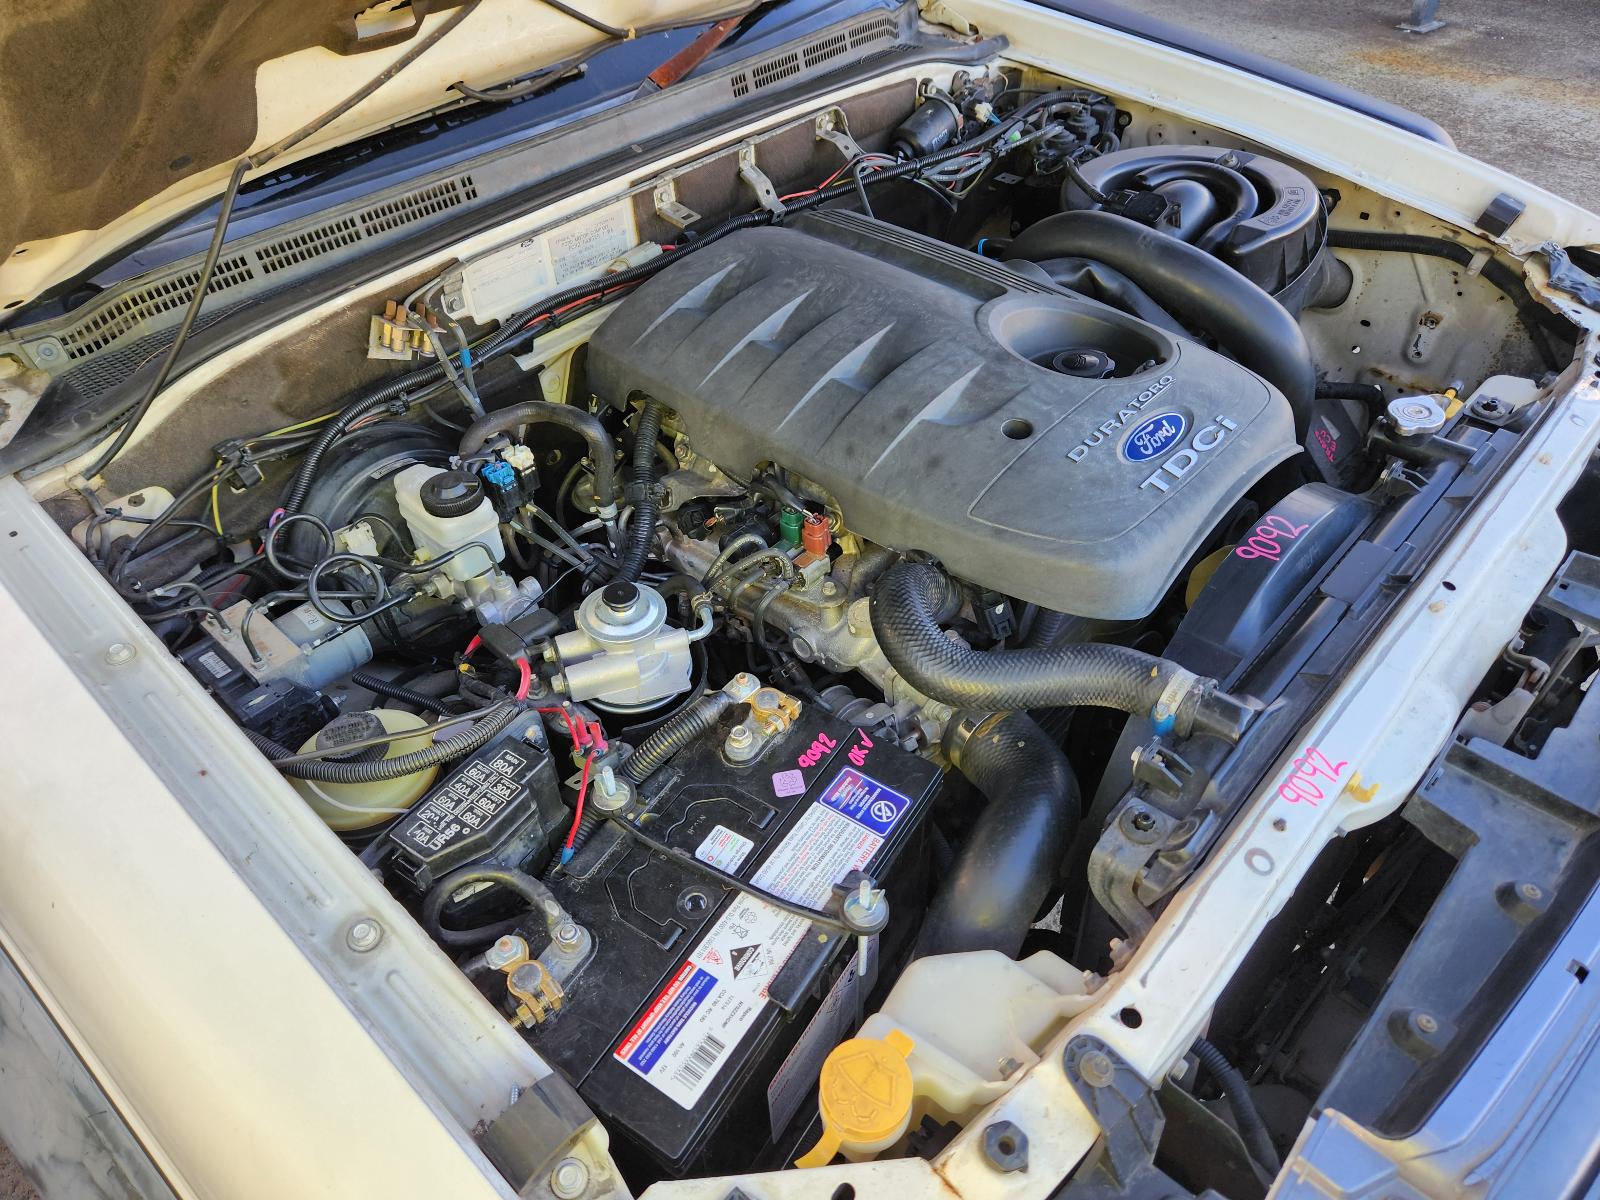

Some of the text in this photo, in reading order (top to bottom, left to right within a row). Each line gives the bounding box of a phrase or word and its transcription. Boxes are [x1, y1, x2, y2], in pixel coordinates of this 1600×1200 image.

[1066, 375, 1177, 464] DURATORQ
[1134, 419, 1176, 455] Ford
[1139, 415, 1237, 493] TDCi
[1235, 515, 1309, 561] 9092
[798, 732, 837, 768] 9092
[468, 768, 486, 783] 60A
[493, 759, 514, 775] 80A
[1279, 746, 1348, 807] 9092
[454, 782, 471, 796] 40A
[493, 783, 512, 798] 30A
[438, 795, 455, 811] 60A
[478, 798, 496, 812] 60A
[462, 811, 481, 826] 60A
[429, 824, 461, 850] UR56
[855, 835, 880, 866] BATTERY,
